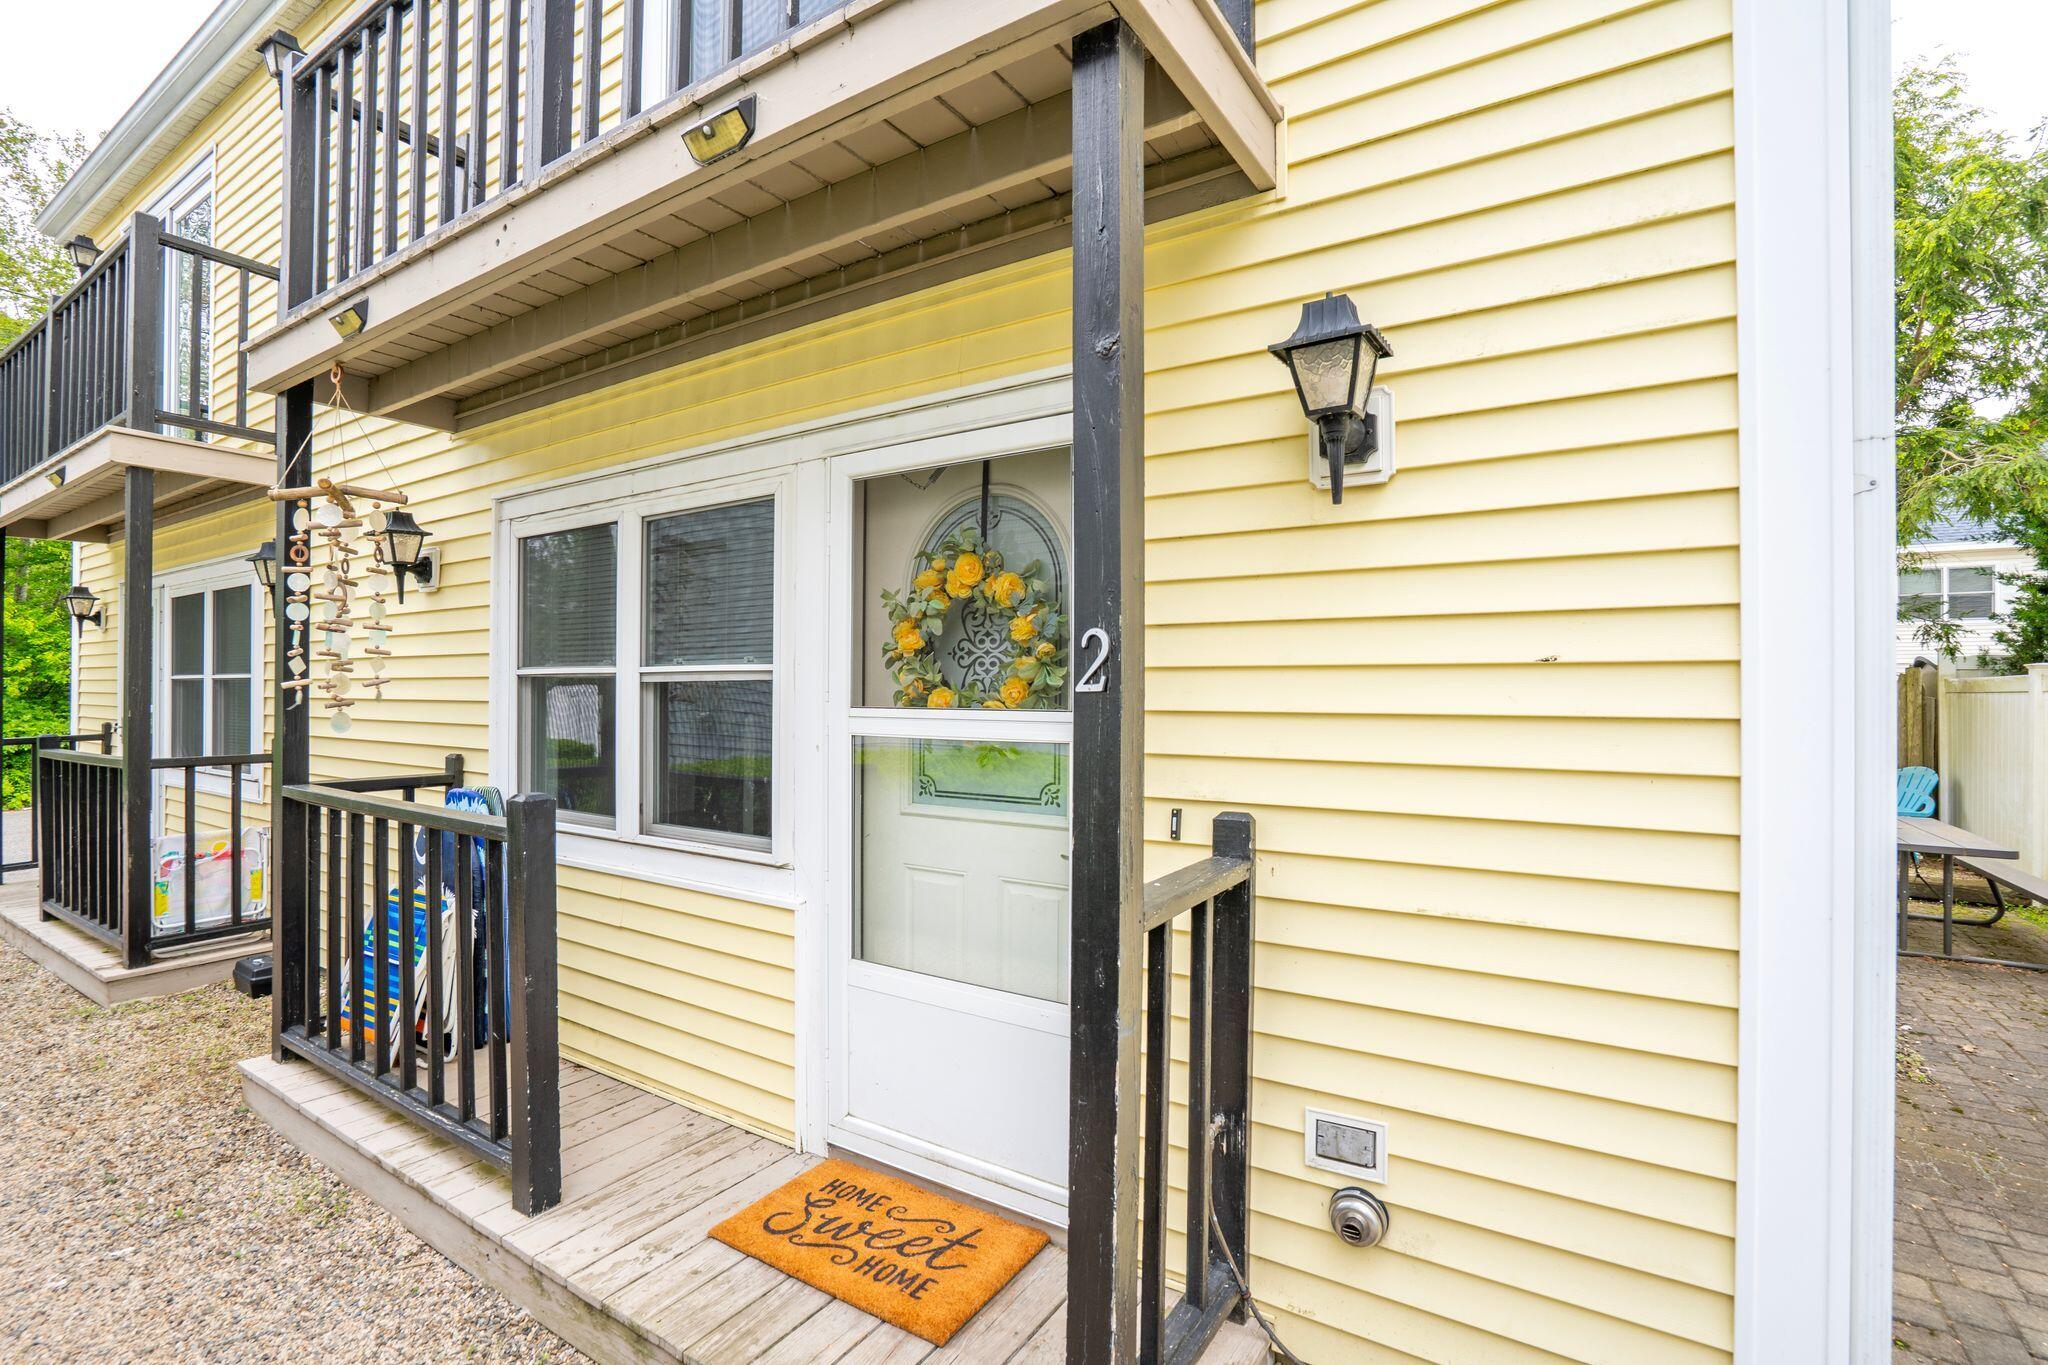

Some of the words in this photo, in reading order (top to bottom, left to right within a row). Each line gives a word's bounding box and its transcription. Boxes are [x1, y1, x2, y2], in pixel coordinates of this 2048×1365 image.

[1075, 627, 1109, 692] 2
[819, 1178, 892, 1213] HOME
[763, 1191, 983, 1271] Sweet
[853, 1255, 939, 1300] HOME
